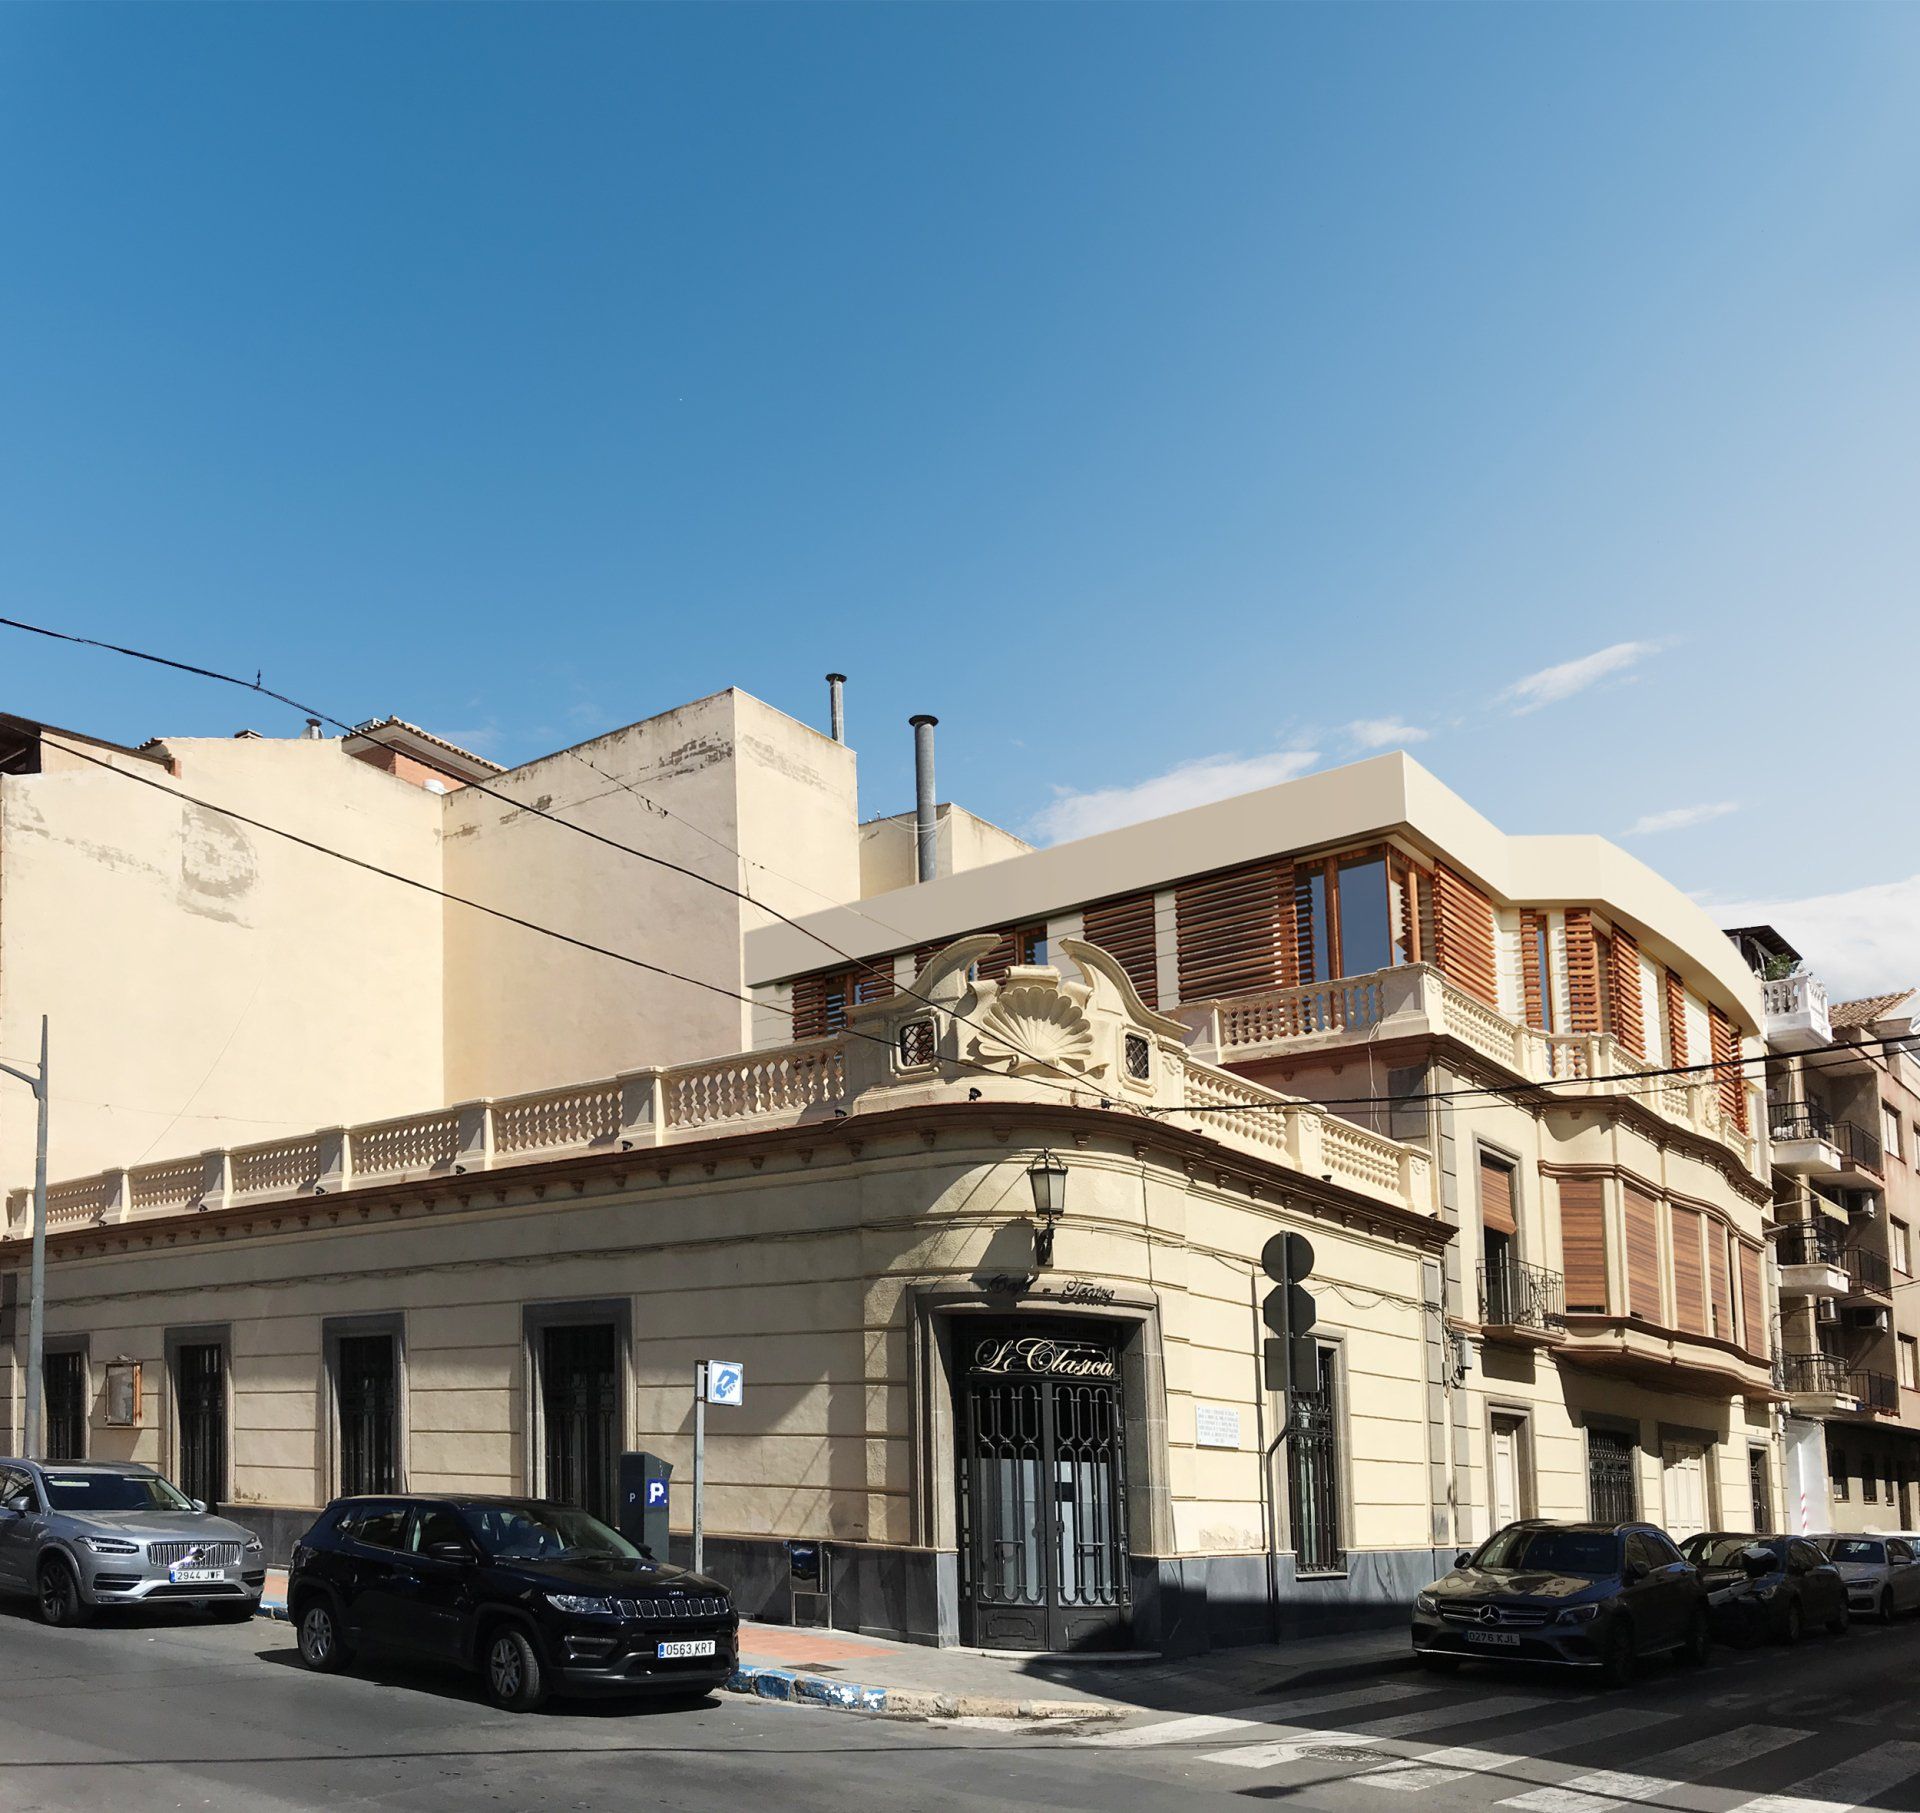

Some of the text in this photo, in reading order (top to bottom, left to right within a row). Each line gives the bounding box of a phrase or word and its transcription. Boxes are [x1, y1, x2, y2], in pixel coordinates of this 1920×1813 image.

[1061, 1275, 1115, 1301] Teatro
[629, 1492, 636, 1503] P
[177, 1571, 201, 1580] 2944
[666, 1641, 713, 1656] 0563 KRT
